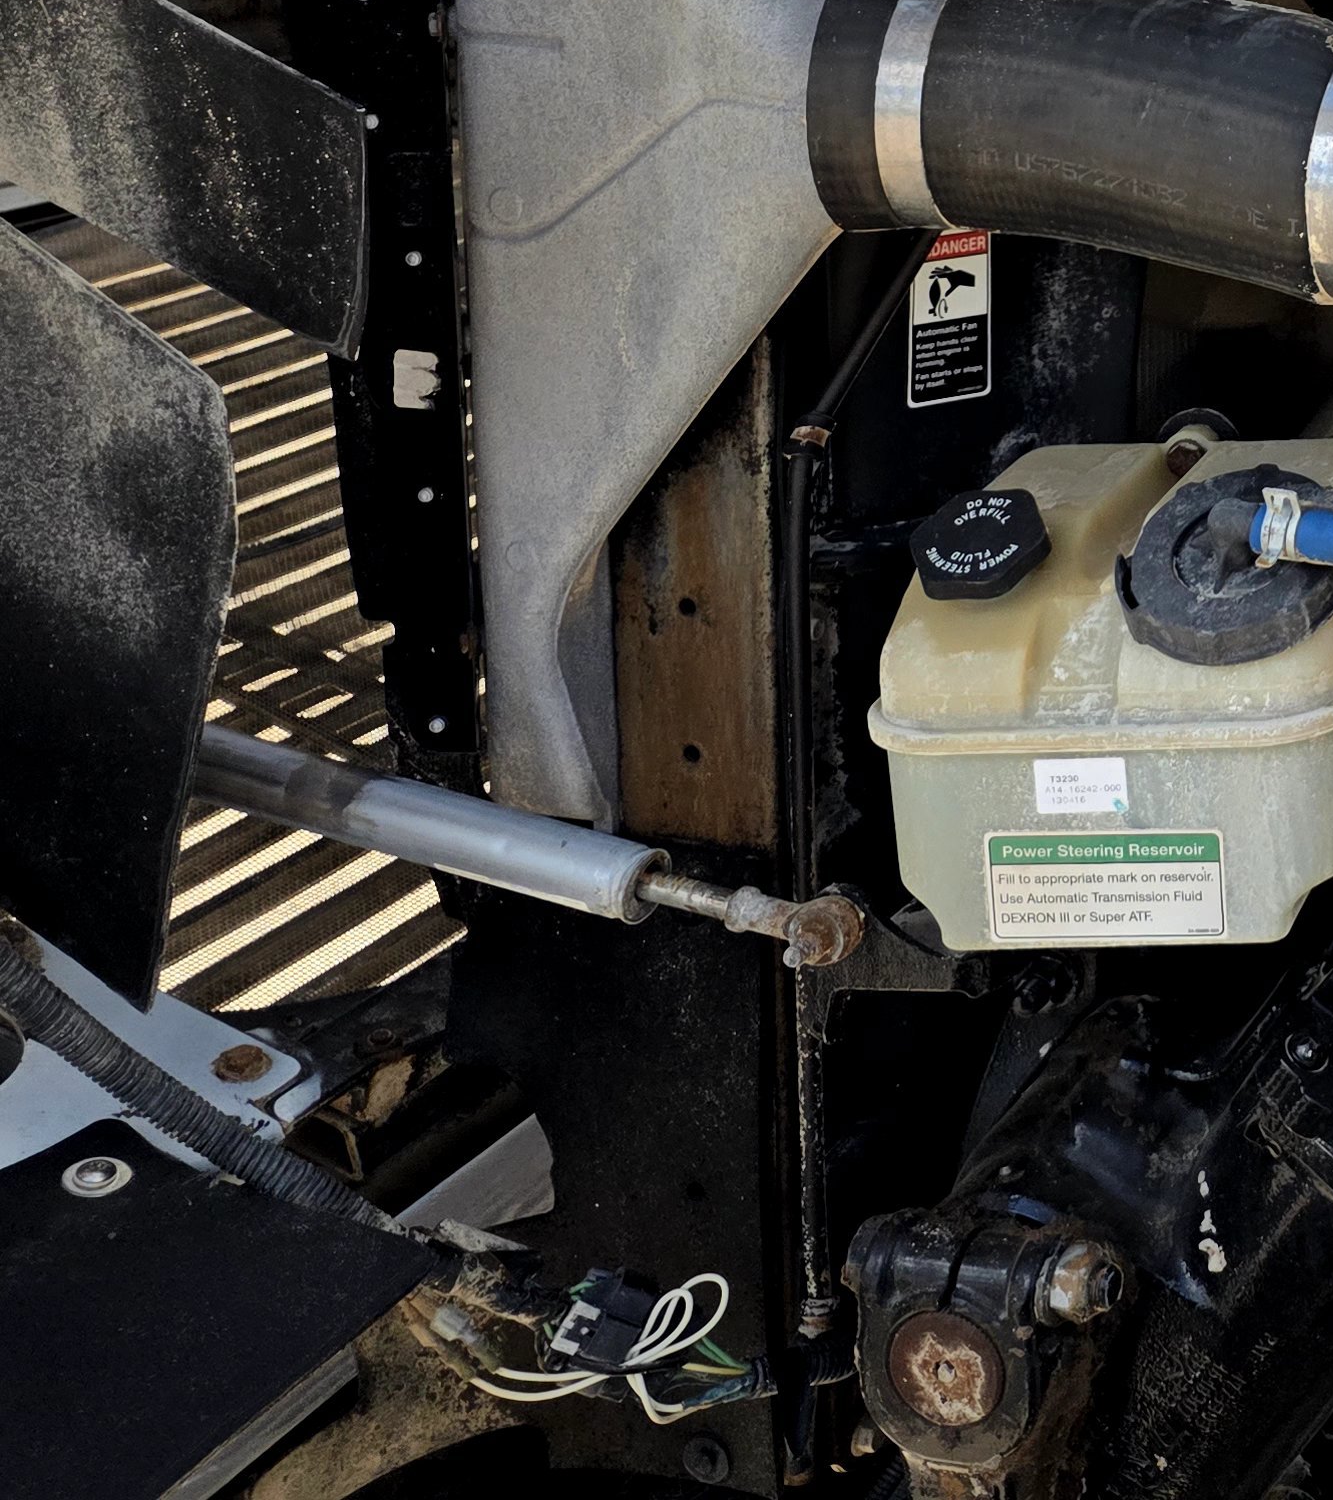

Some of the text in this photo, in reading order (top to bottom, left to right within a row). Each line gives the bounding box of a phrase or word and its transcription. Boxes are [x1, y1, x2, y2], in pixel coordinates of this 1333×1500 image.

[931, 235, 986, 258] DANGER
[916, 322, 978, 338] Automatic Fan
[916, 335, 978, 352] Keep hands clear
[916, 351, 936, 360] when
[937, 347, 962, 357] engine
[916, 372, 930, 381] Fan
[931, 369, 952, 379] starts
[963, 364, 984, 374] stops
[915, 381, 925, 391] by
[966, 497, 1012, 510] DO NOT
[954, 507, 1012, 526] OVERFILL
[925, 543, 1019, 574] POWER STEERING
[950, 549, 991, 563] FLUID
[1050, 774, 1080, 783] T3230
[1002, 843, 1205, 859] Power Steering Reservoir
[998, 871, 1214, 887] Fill to appropriate mark on reservoir.
[1000, 890, 1203, 905] Use Automatic Transmission Fluid
[1001, 911, 1154, 925] DEXRON III or Super ATF.
